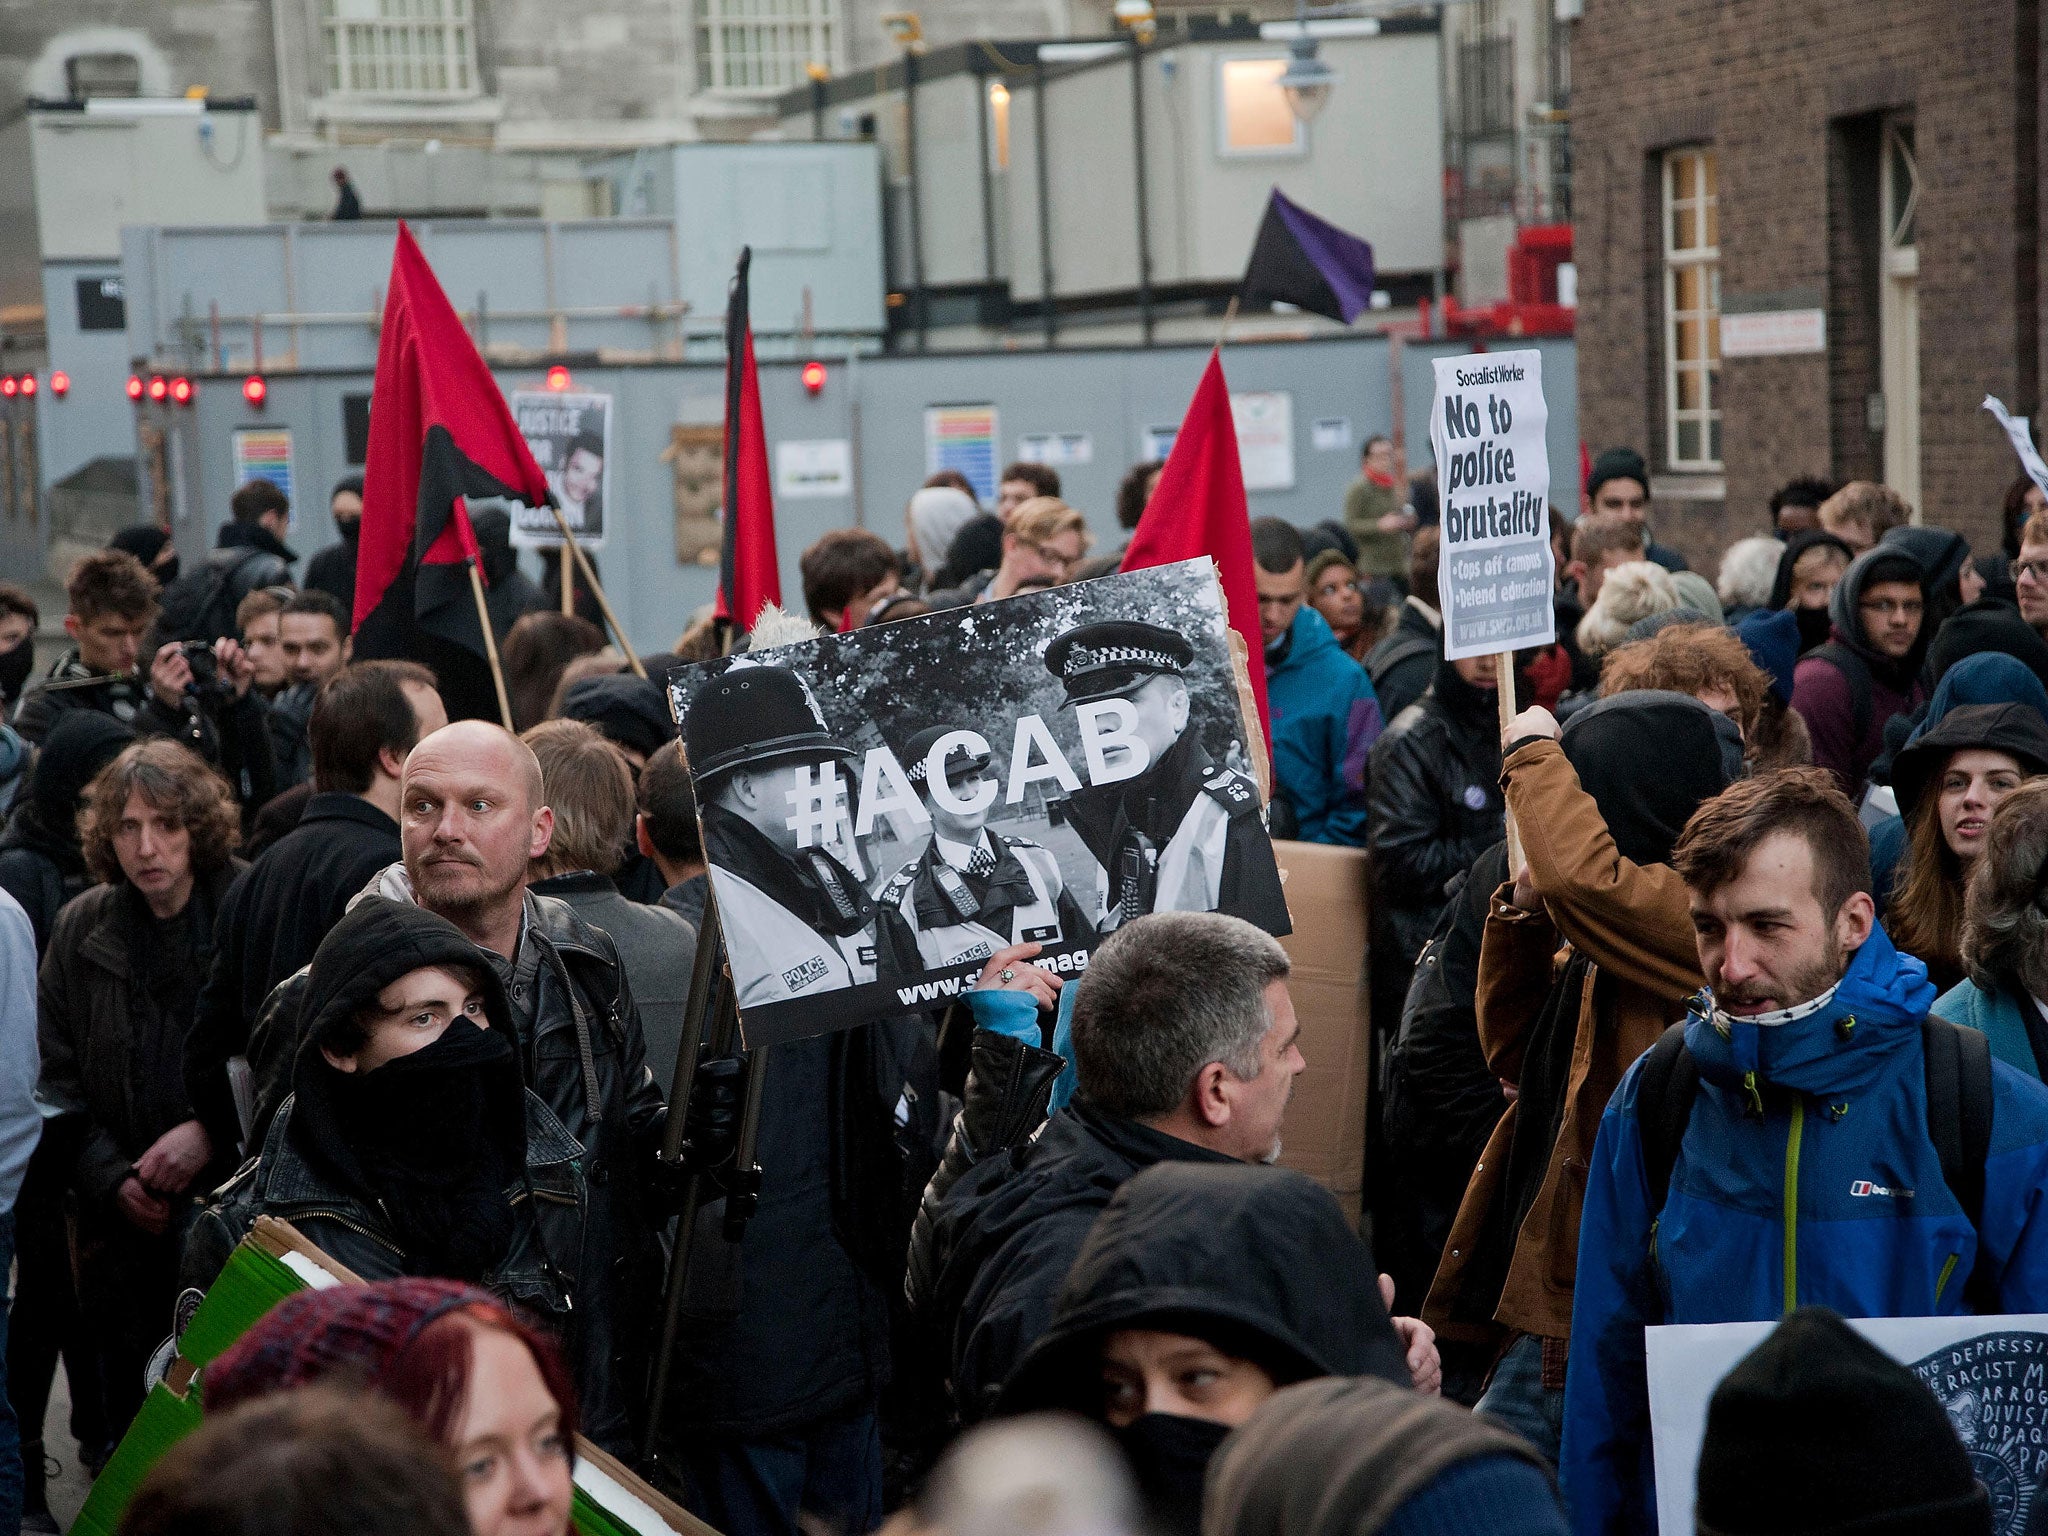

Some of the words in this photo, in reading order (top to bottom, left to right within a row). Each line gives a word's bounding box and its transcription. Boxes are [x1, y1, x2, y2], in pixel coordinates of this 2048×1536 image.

[1445, 394, 1481, 440] No
[1489, 394, 1513, 435] to
[1448, 440, 1517, 494] police
[1446, 490, 1543, 544] brutality
[1484, 554, 1503, 577] off
[1506, 552, 1542, 573] campus
[1501, 577, 1546, 602] education
[784, 697, 1152, 850] #ACAB
[946, 941, 989, 967] POLICE
[783, 955, 826, 986] POLICE
[1952, 1338, 2048, 1366] DEPRESSI
[1946, 1360, 2017, 1391] RACIST
[1981, 1385, 2048, 1405] ARROG
